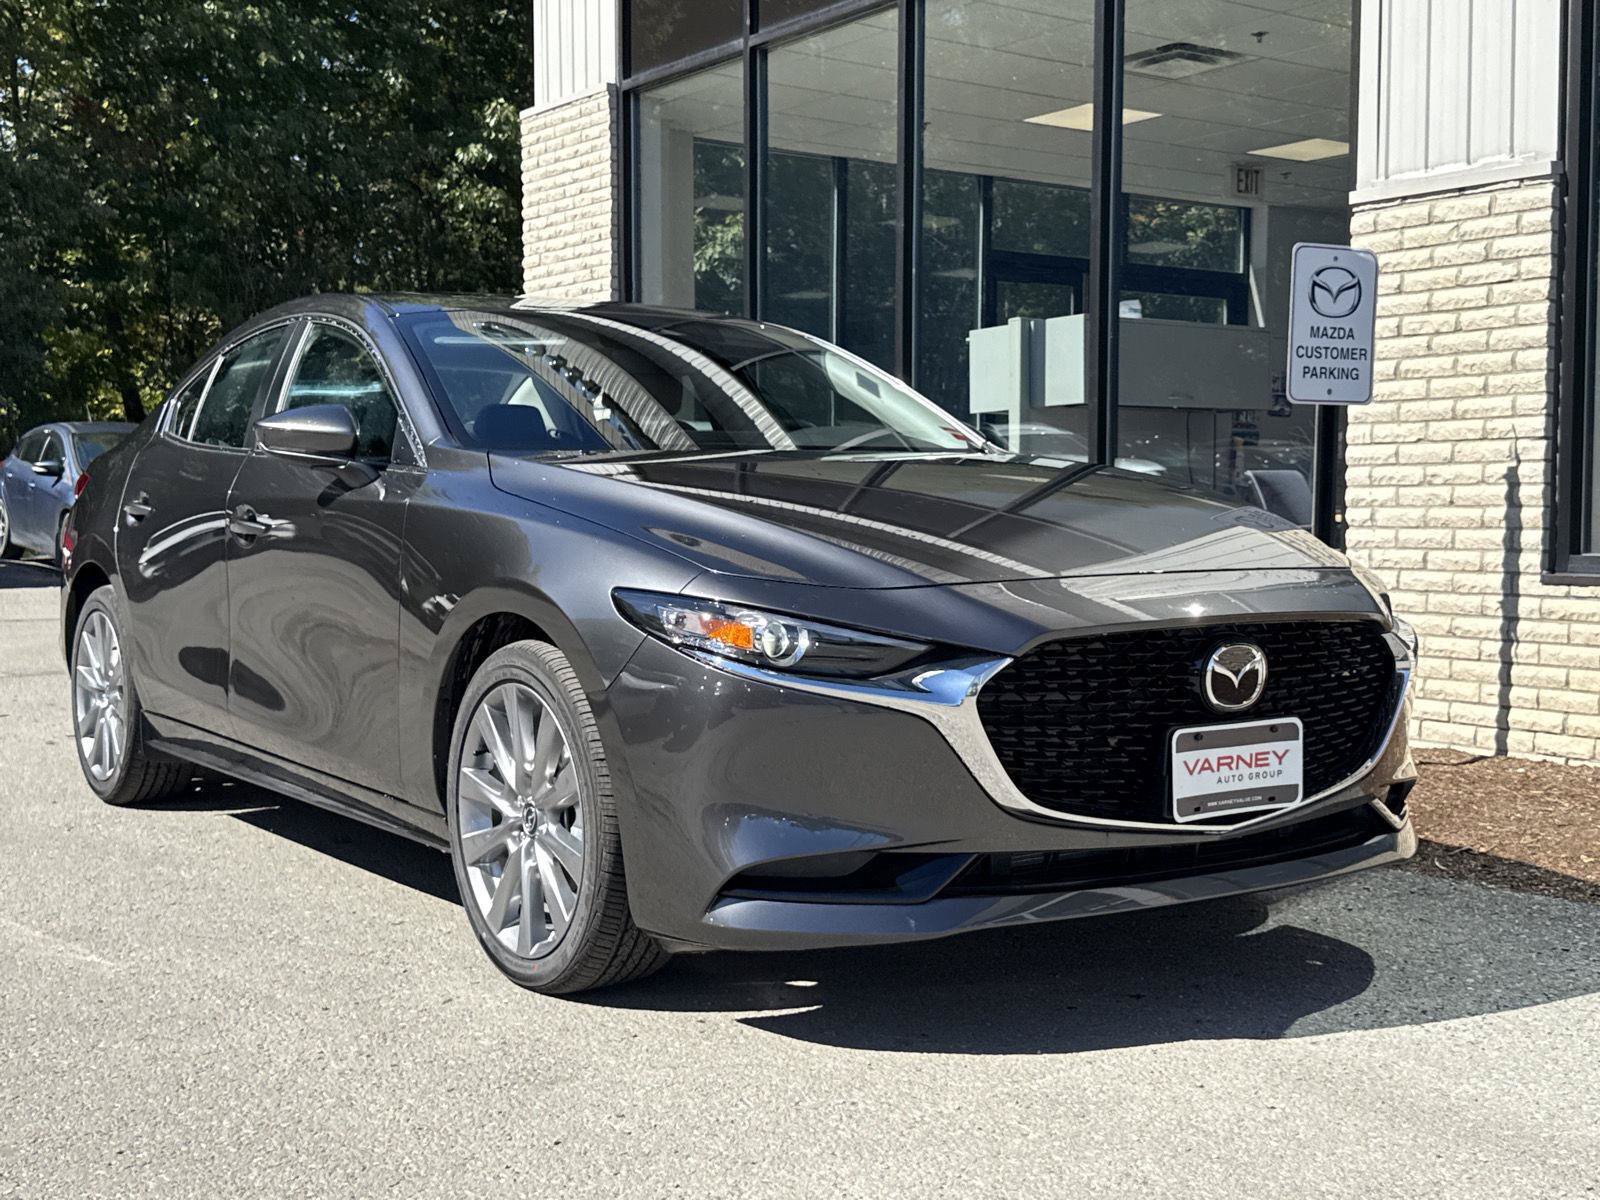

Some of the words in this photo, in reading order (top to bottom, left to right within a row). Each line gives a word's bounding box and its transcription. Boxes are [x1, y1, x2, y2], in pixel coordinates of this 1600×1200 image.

[1236, 168, 1259, 195] EXIT
[1309, 326, 1355, 341] MAZDA
[1296, 345, 1368, 361] CUSTOMER
[1302, 366, 1360, 381] PARKING
[1183, 749, 1290, 776] VARNEY
[1216, 773, 1244, 784] AUTO
[1248, 769, 1283, 781] GROUP
